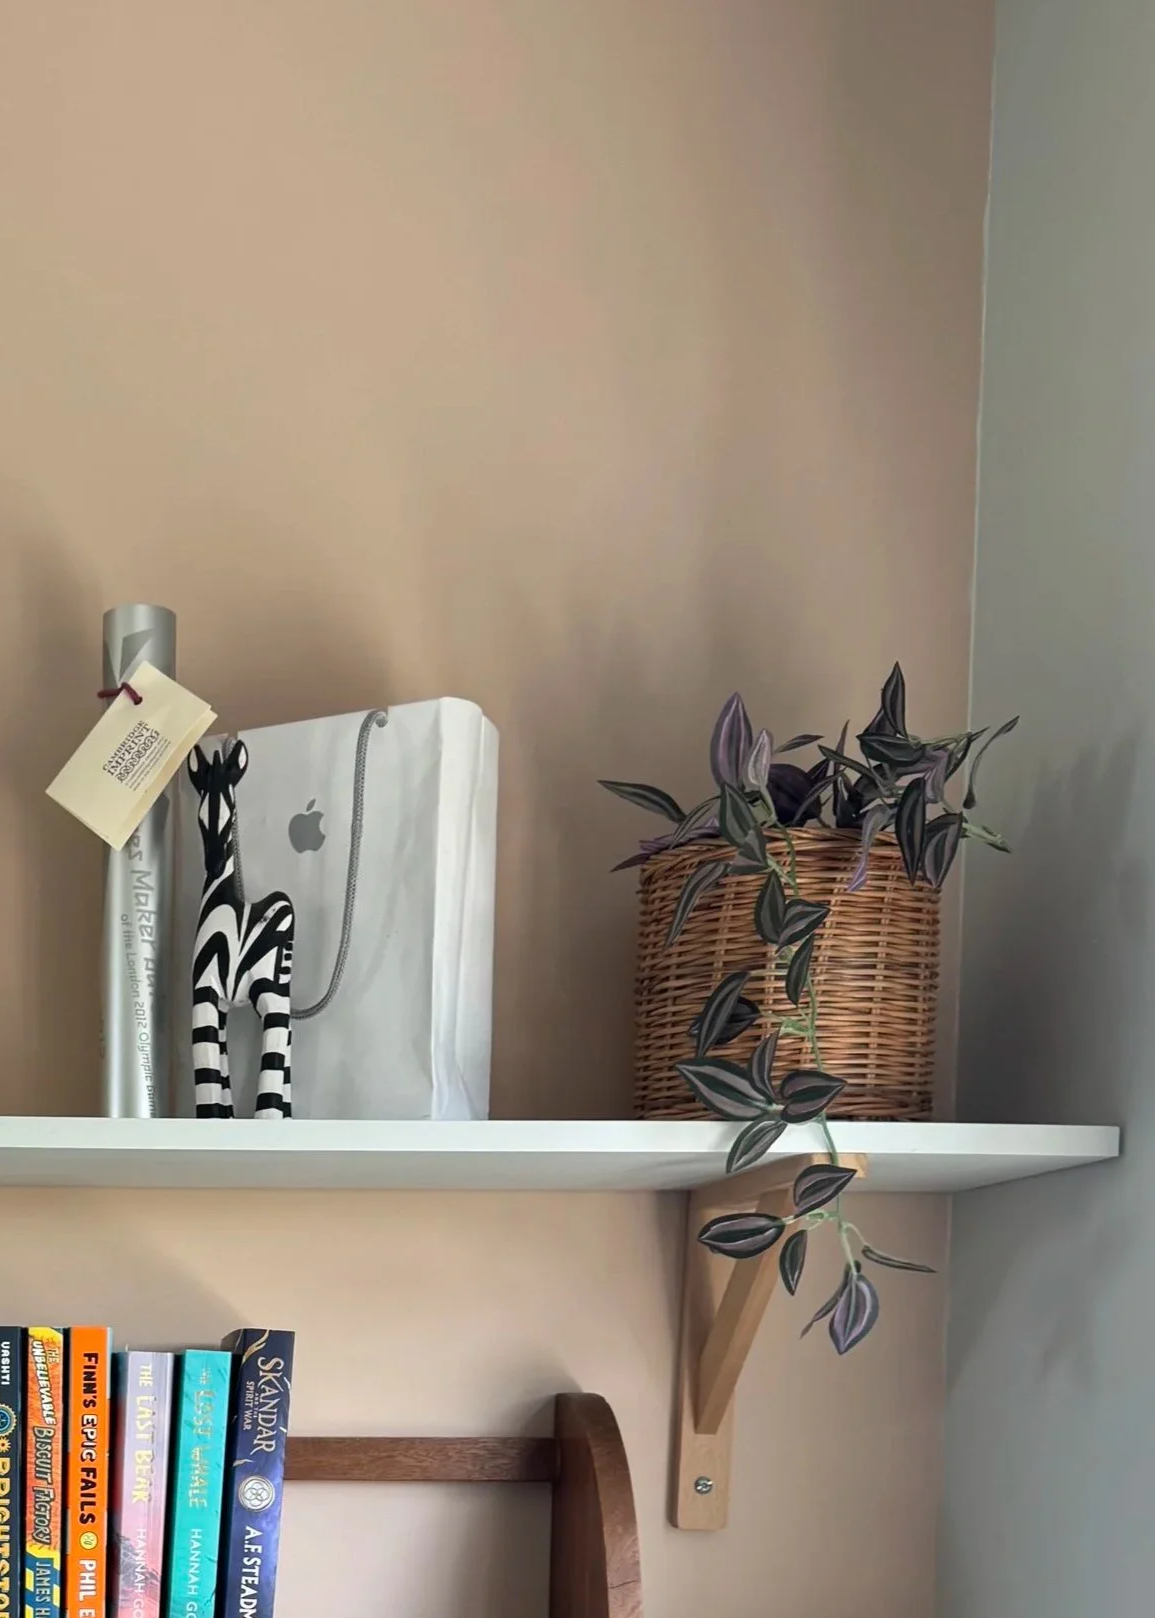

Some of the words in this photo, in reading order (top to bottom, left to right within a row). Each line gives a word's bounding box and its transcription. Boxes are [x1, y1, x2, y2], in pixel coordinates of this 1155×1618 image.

[103, 720, 145, 771] CAMBRIDGE
[107, 723, 150, 775] IMPRINT
[121, 913, 133, 926] of
[130, 869, 157, 951] Maker
[123, 930, 135, 949] the
[126, 952, 140, 998] London
[134, 1001, 148, 1029] 2012
[137, 1032, 153, 1083] Olympic
[48, 1347, 59, 1365] THE
[83, 1353, 98, 1408] FINN'S
[139, 1363, 153, 1387] THE
[32, 1340, 57, 1426] UNBELIEVABLE
[245, 1381, 255, 1407] SPIRIT
[250, 1356, 284, 1456] SKANDAR
[80, 1414, 97, 1462] EPIC
[135, 1395, 155, 1440] LAST
[243, 1409, 253, 1430] WAR
[33, 1426, 55, 1485] BISCUIT
[132, 1450, 154, 1504] BEAR
[32, 1486, 55, 1544] FACTORY
[79, 1467, 97, 1524] FAILS
[36, 1561, 51, 1603] JAMES
[78, 1559, 97, 1601] PHIL
[134, 1528, 147, 1593] HANNAH
[187, 1528, 202, 1595] HANNAH
